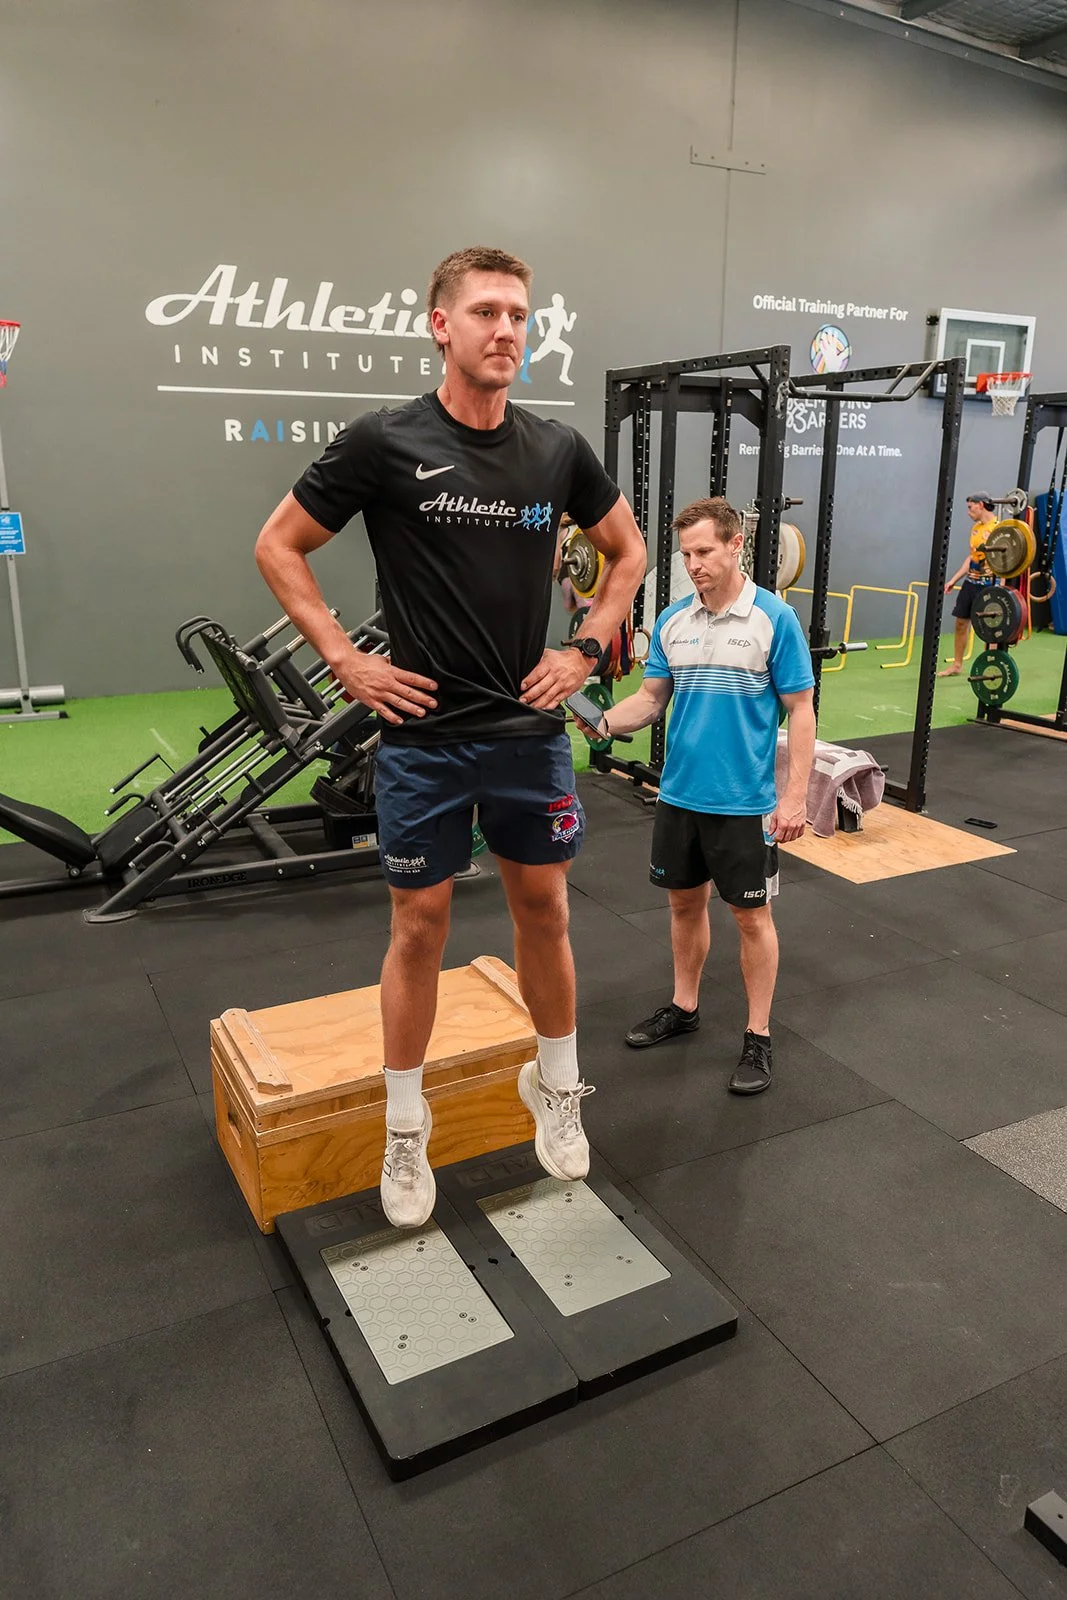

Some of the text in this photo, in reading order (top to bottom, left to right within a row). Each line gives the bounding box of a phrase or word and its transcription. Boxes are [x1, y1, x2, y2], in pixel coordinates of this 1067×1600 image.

[145, 264, 433, 338] Athletic
[753, 295, 908, 321] Official Training Partner For
[174, 344, 431, 376] INSTITUTE
[224, 419, 346, 443] RAISIN
[836, 444, 855, 456] One
[856, 445, 868, 456] At
[868, 445, 876, 456] A
[877, 445, 903, 457] Time.
[419, 492, 517, 517] Athletic
[426, 515, 510, 528] INSTITUTE
